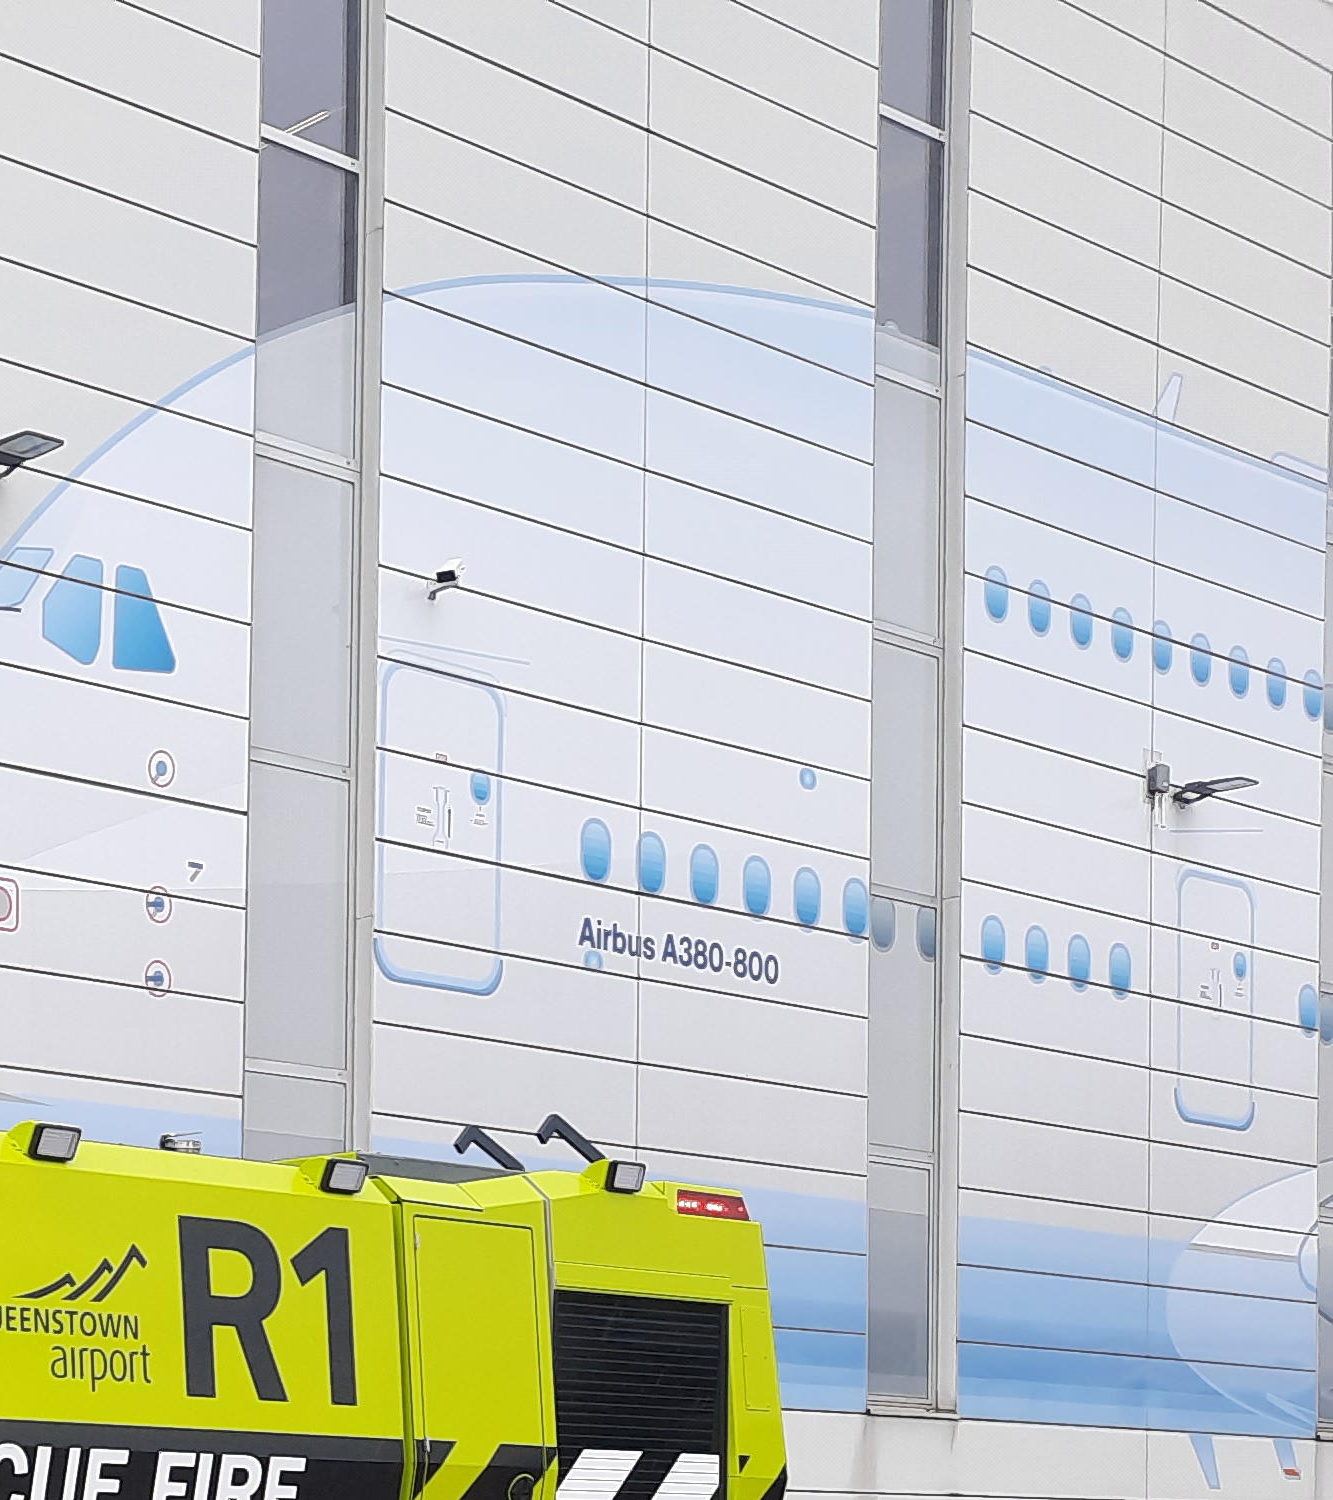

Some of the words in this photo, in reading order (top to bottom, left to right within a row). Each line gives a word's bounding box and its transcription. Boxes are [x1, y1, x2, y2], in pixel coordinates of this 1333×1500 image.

[578, 917, 656, 960] Airbus
[661, 933, 779, 985] A380-800
[177, 1214, 358, 1406] R1
[50, 1344, 152, 1392] airport
